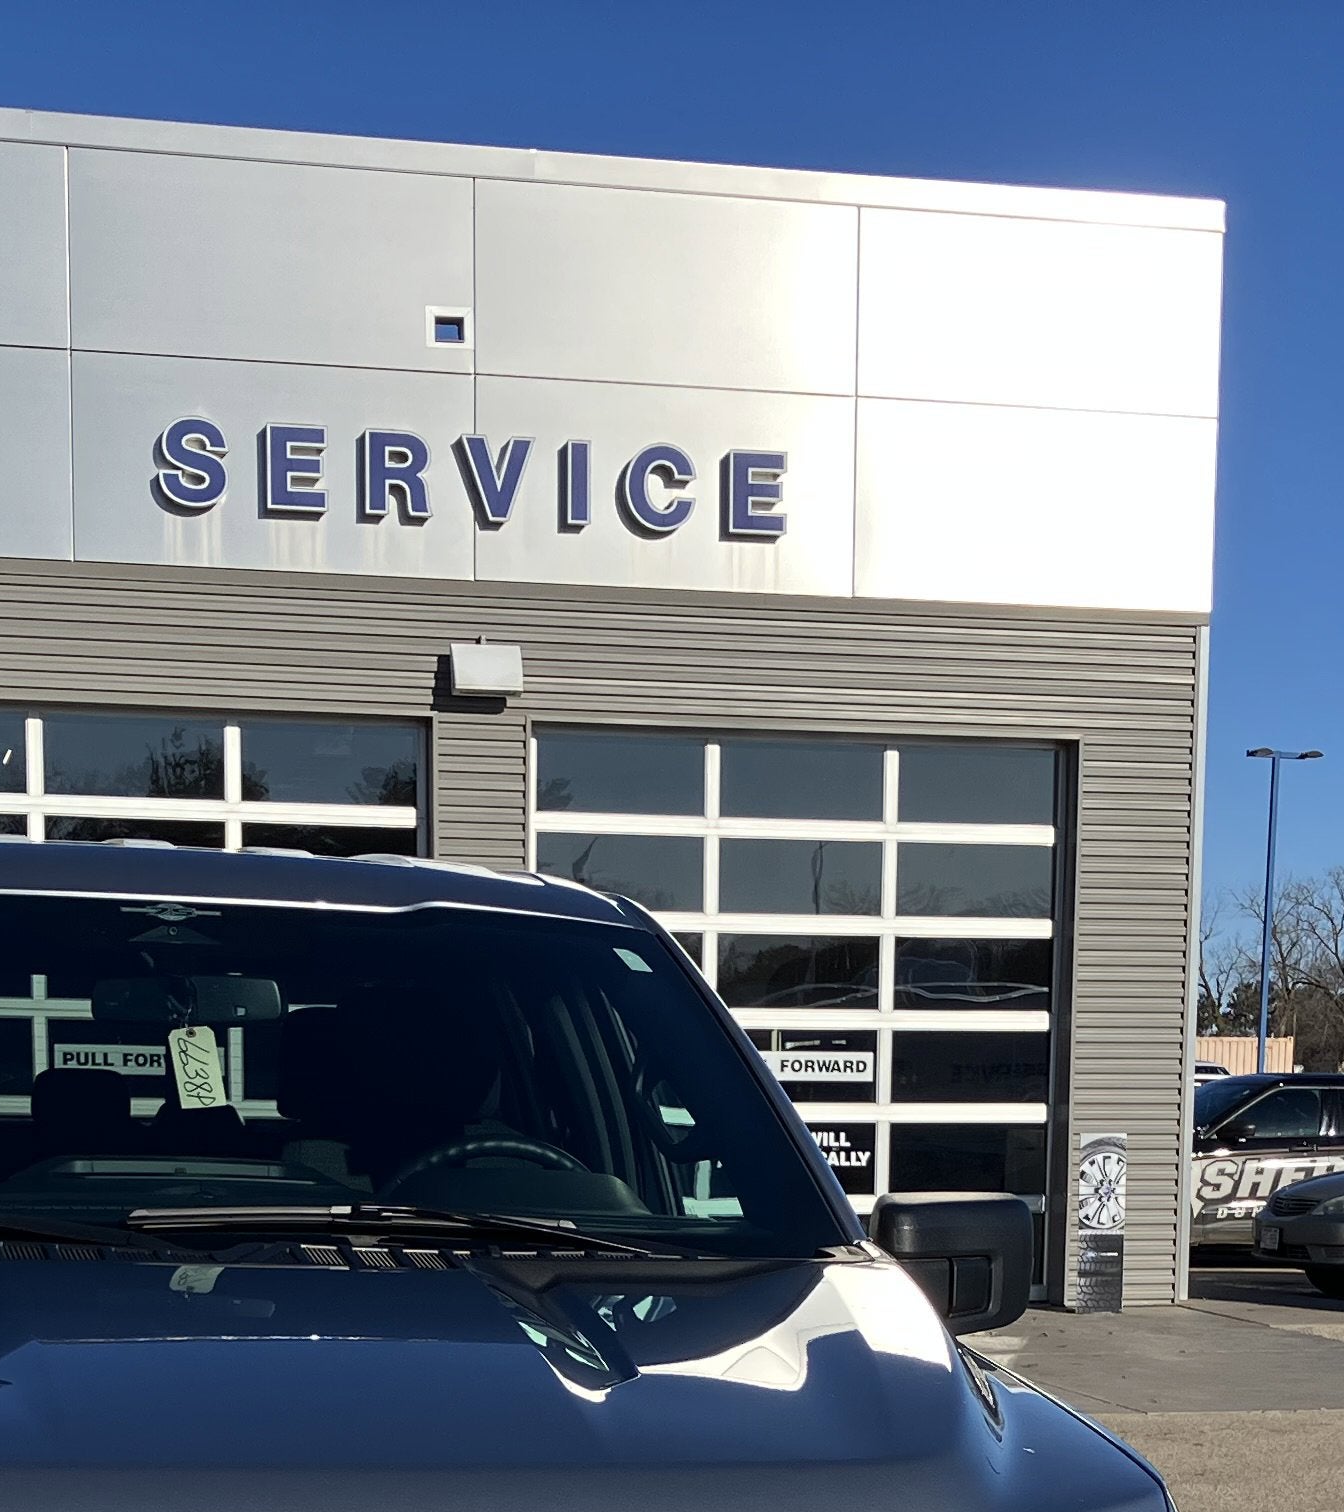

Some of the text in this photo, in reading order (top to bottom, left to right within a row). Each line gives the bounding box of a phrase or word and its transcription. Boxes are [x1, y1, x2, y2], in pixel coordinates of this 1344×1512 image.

[152, 416, 788, 540] SERVICE
[62, 1052, 165, 1068] PULL FOR
[779, 1059, 868, 1073] FORWARD
[820, 1150, 871, 1167] ALLY
